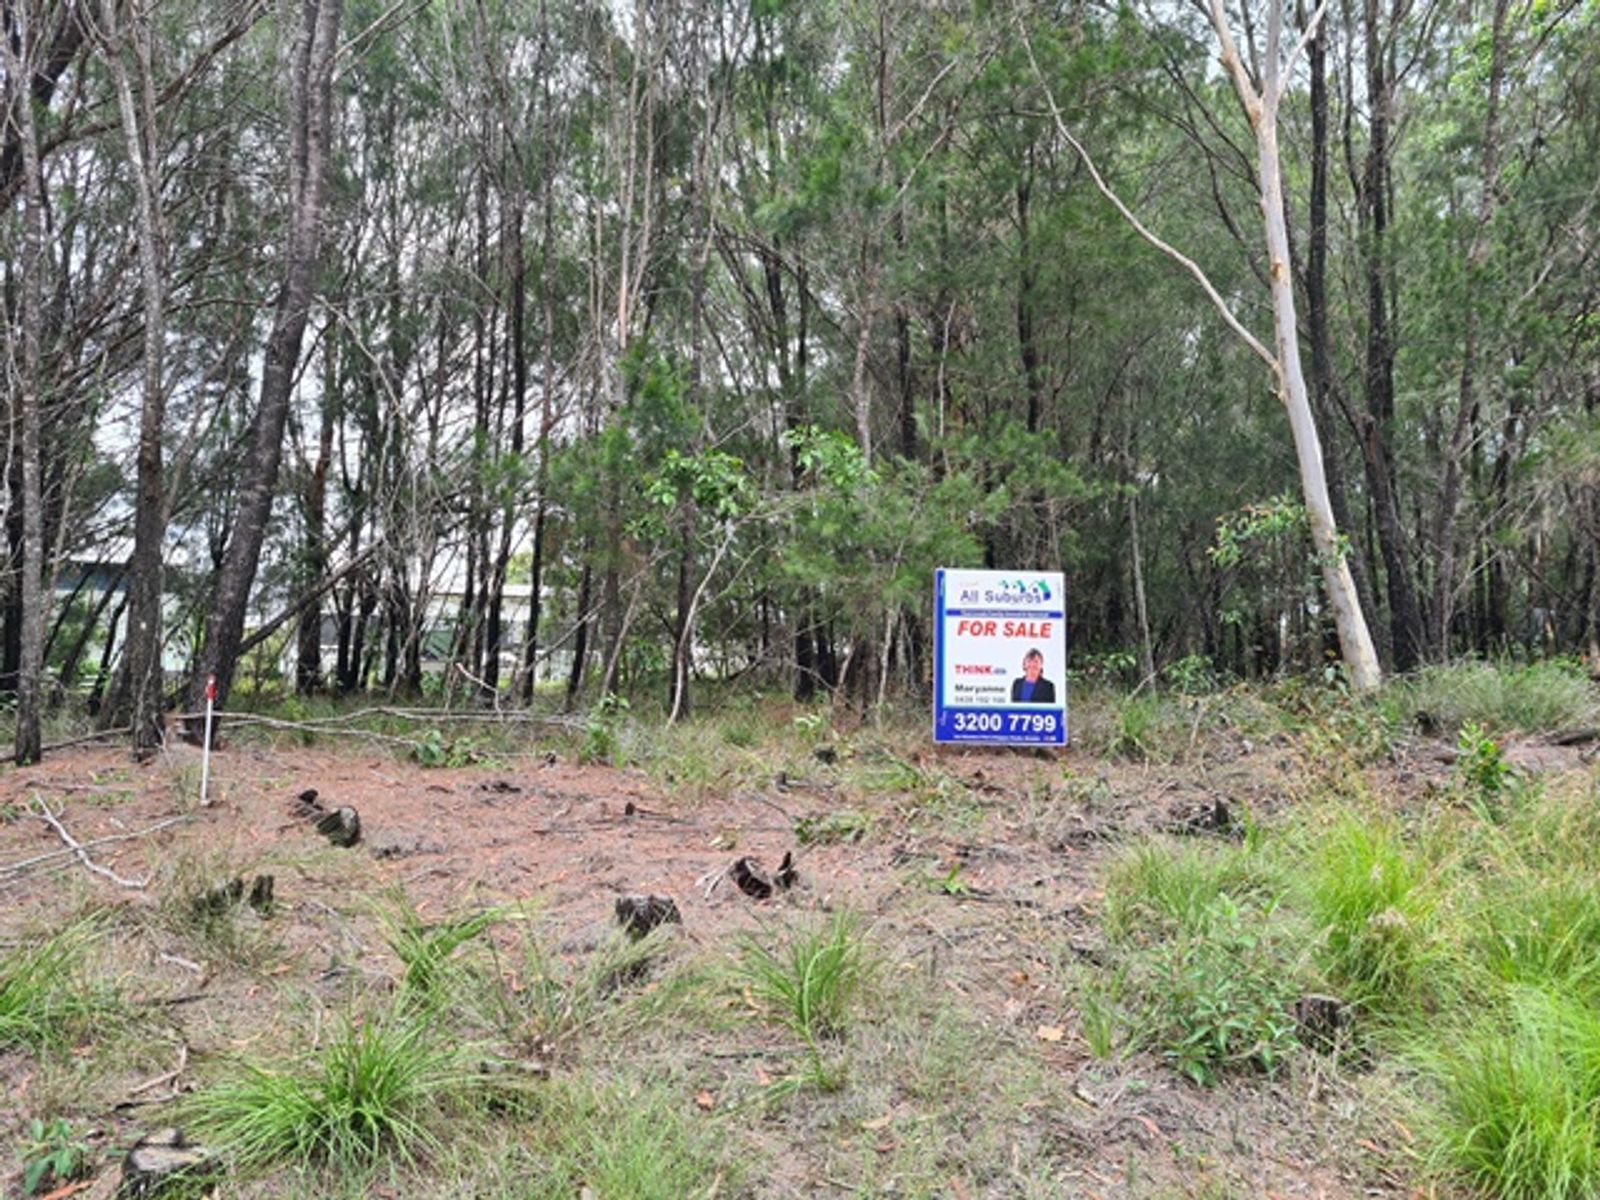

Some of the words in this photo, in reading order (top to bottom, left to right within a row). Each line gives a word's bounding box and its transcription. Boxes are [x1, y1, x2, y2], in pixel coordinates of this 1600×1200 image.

[960, 590, 978, 602] All
[985, 590, 1041, 603] Suburbs
[957, 620, 997, 636] FOR
[1003, 621, 1052, 638] SALE
[954, 712, 1002, 731] 3200
[1008, 714, 1056, 732] 7799
